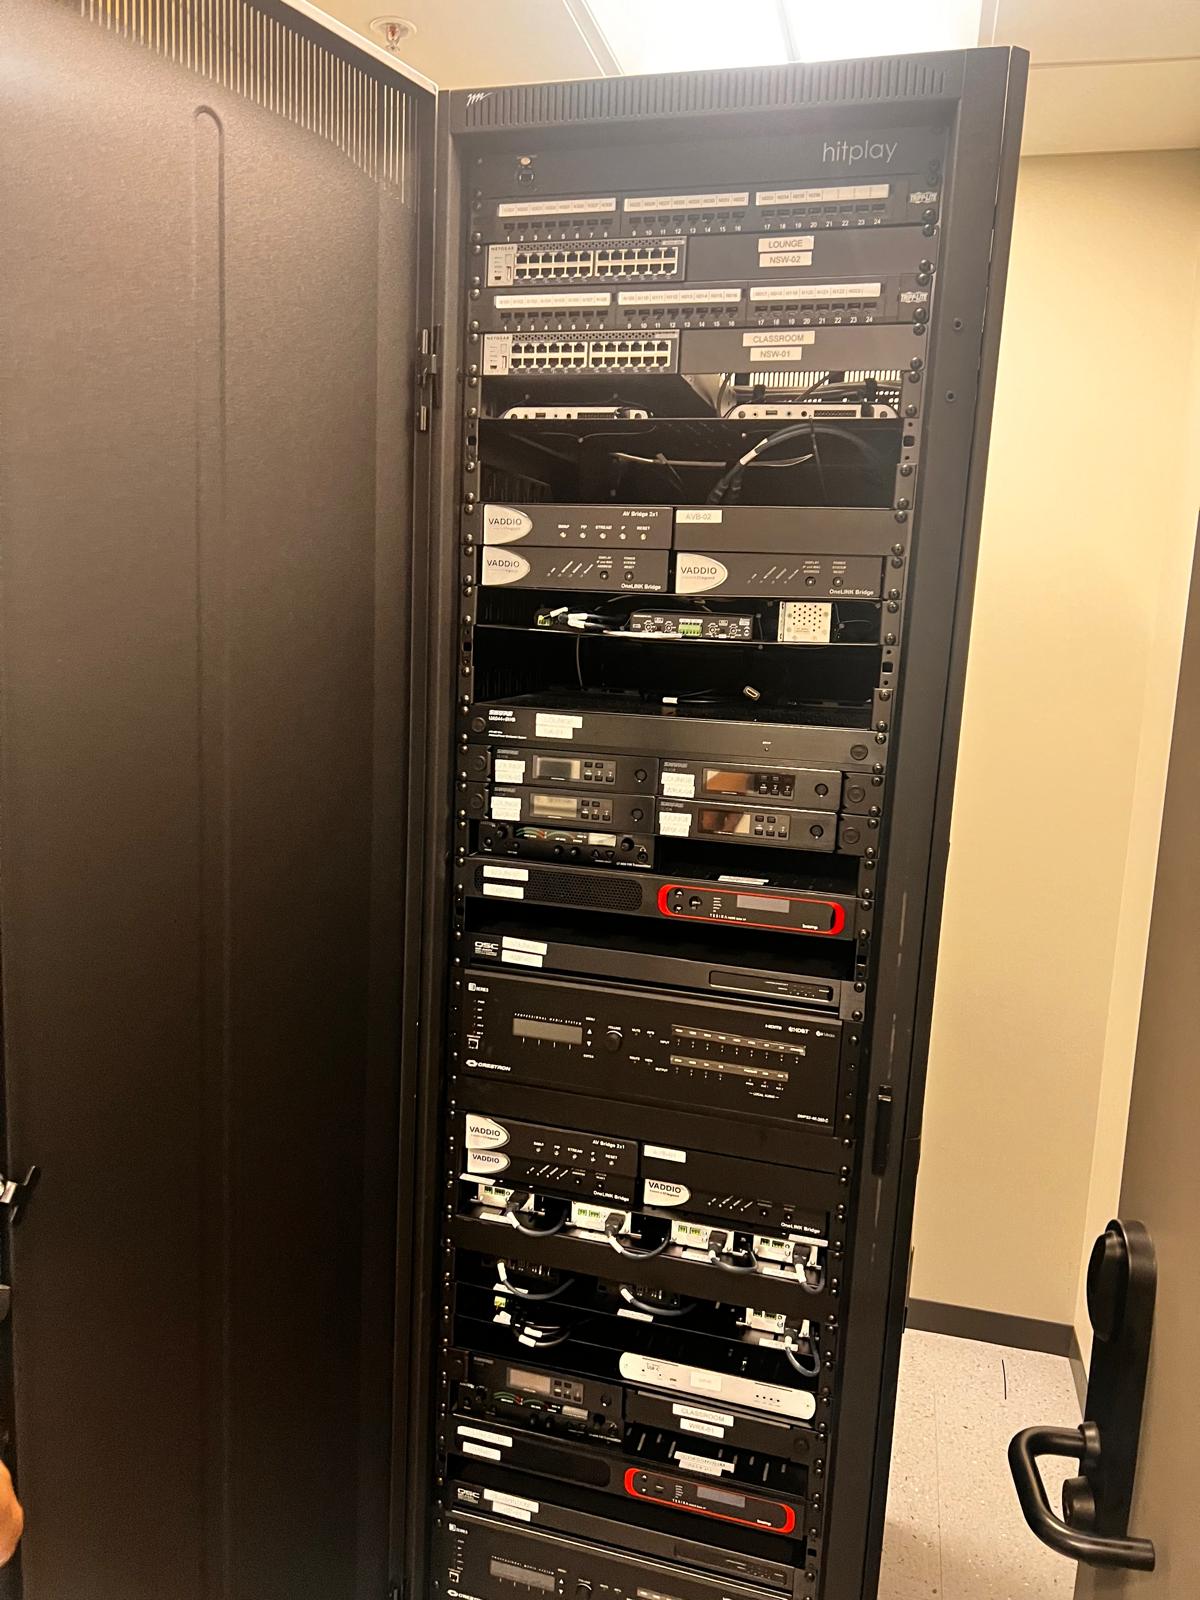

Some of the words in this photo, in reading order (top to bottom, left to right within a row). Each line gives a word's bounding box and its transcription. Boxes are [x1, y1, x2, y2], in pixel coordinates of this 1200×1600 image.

[822, 140, 898, 166] hitplay
[768, 240, 803, 249] LOUNGE
[769, 256, 801, 264] NSW-02
[753, 334, 804, 343] CLASSROOM
[760, 350, 790, 358] NSW-01
[631, 510, 648, 518] Bridge
[685, 513, 711, 521] AVB-02
[488, 517, 522, 526] VADDIO
[487, 559, 520, 568] VADDIO
[680, 566, 717, 575] VADDIO
[475, 941, 499, 950] QSC
[477, 1062, 511, 1072] CRESTRON
[469, 1126, 500, 1137] VADDIO
[600, 1140, 616, 1148] Bridge
[472, 1153, 500, 1164] VADDIO
[648, 1181, 682, 1194] VADDIO
[593, 1190, 613, 1198] OneLINK
[614, 1194, 629, 1202] Bridge
[781, 1222, 802, 1230] OneLINK
[803, 1226, 820, 1234] Bridge
[680, 1407, 725, 1421] CLASSROOM
